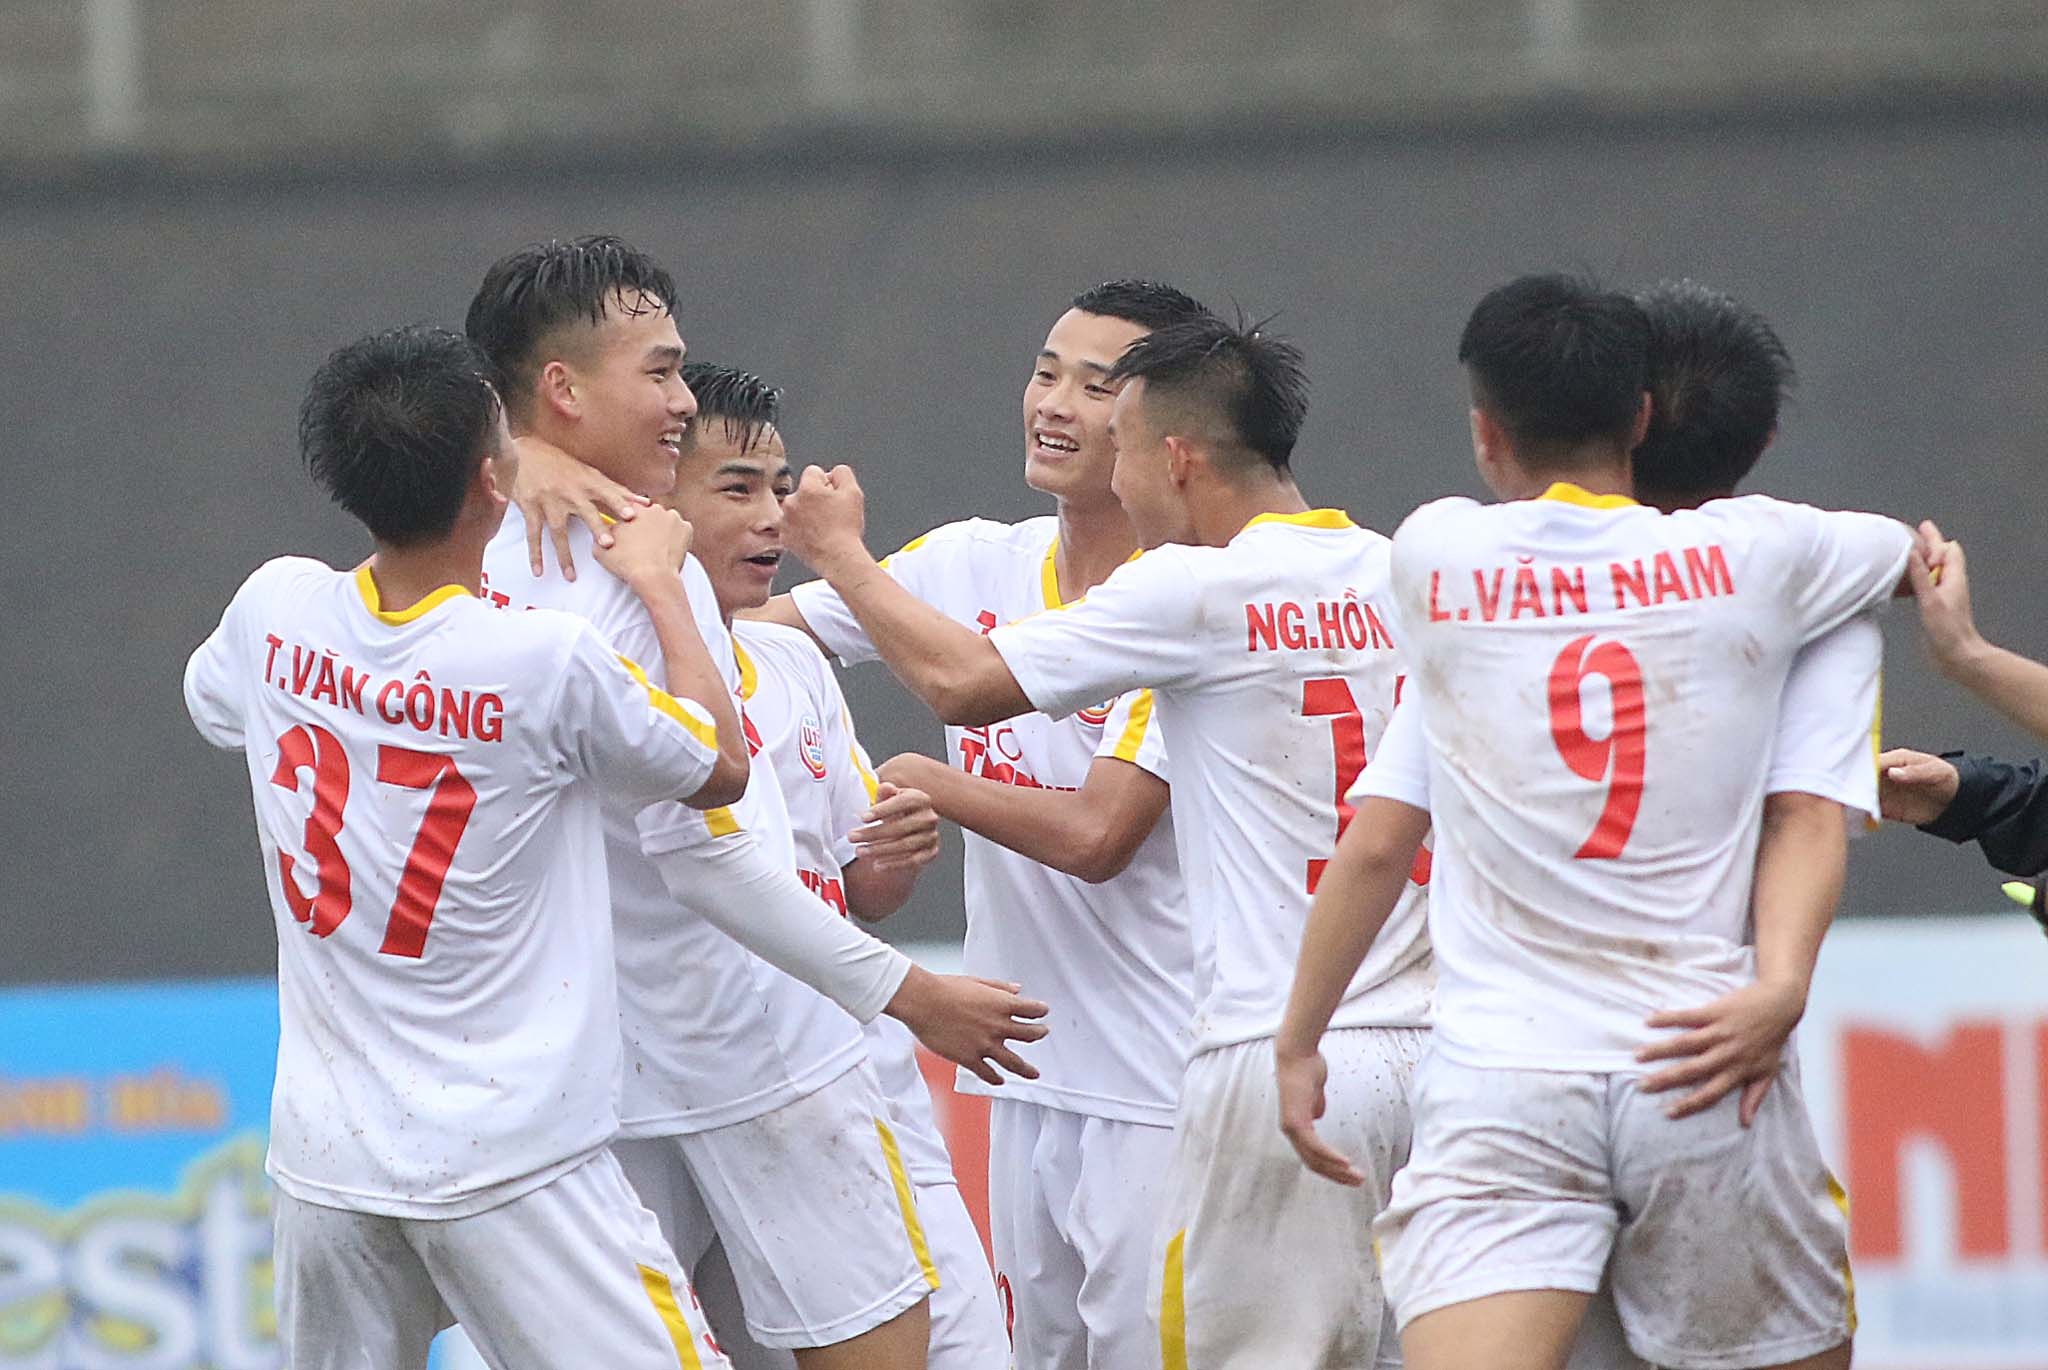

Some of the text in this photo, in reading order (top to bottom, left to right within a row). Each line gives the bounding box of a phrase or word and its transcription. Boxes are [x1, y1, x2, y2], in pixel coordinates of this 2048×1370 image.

[1429, 545, 1735, 623] L.VĂN NAM
[265, 633, 504, 743] T.VĂN CÔNG
[1547, 634, 1646, 859] 9
[271, 723, 478, 959] 37
